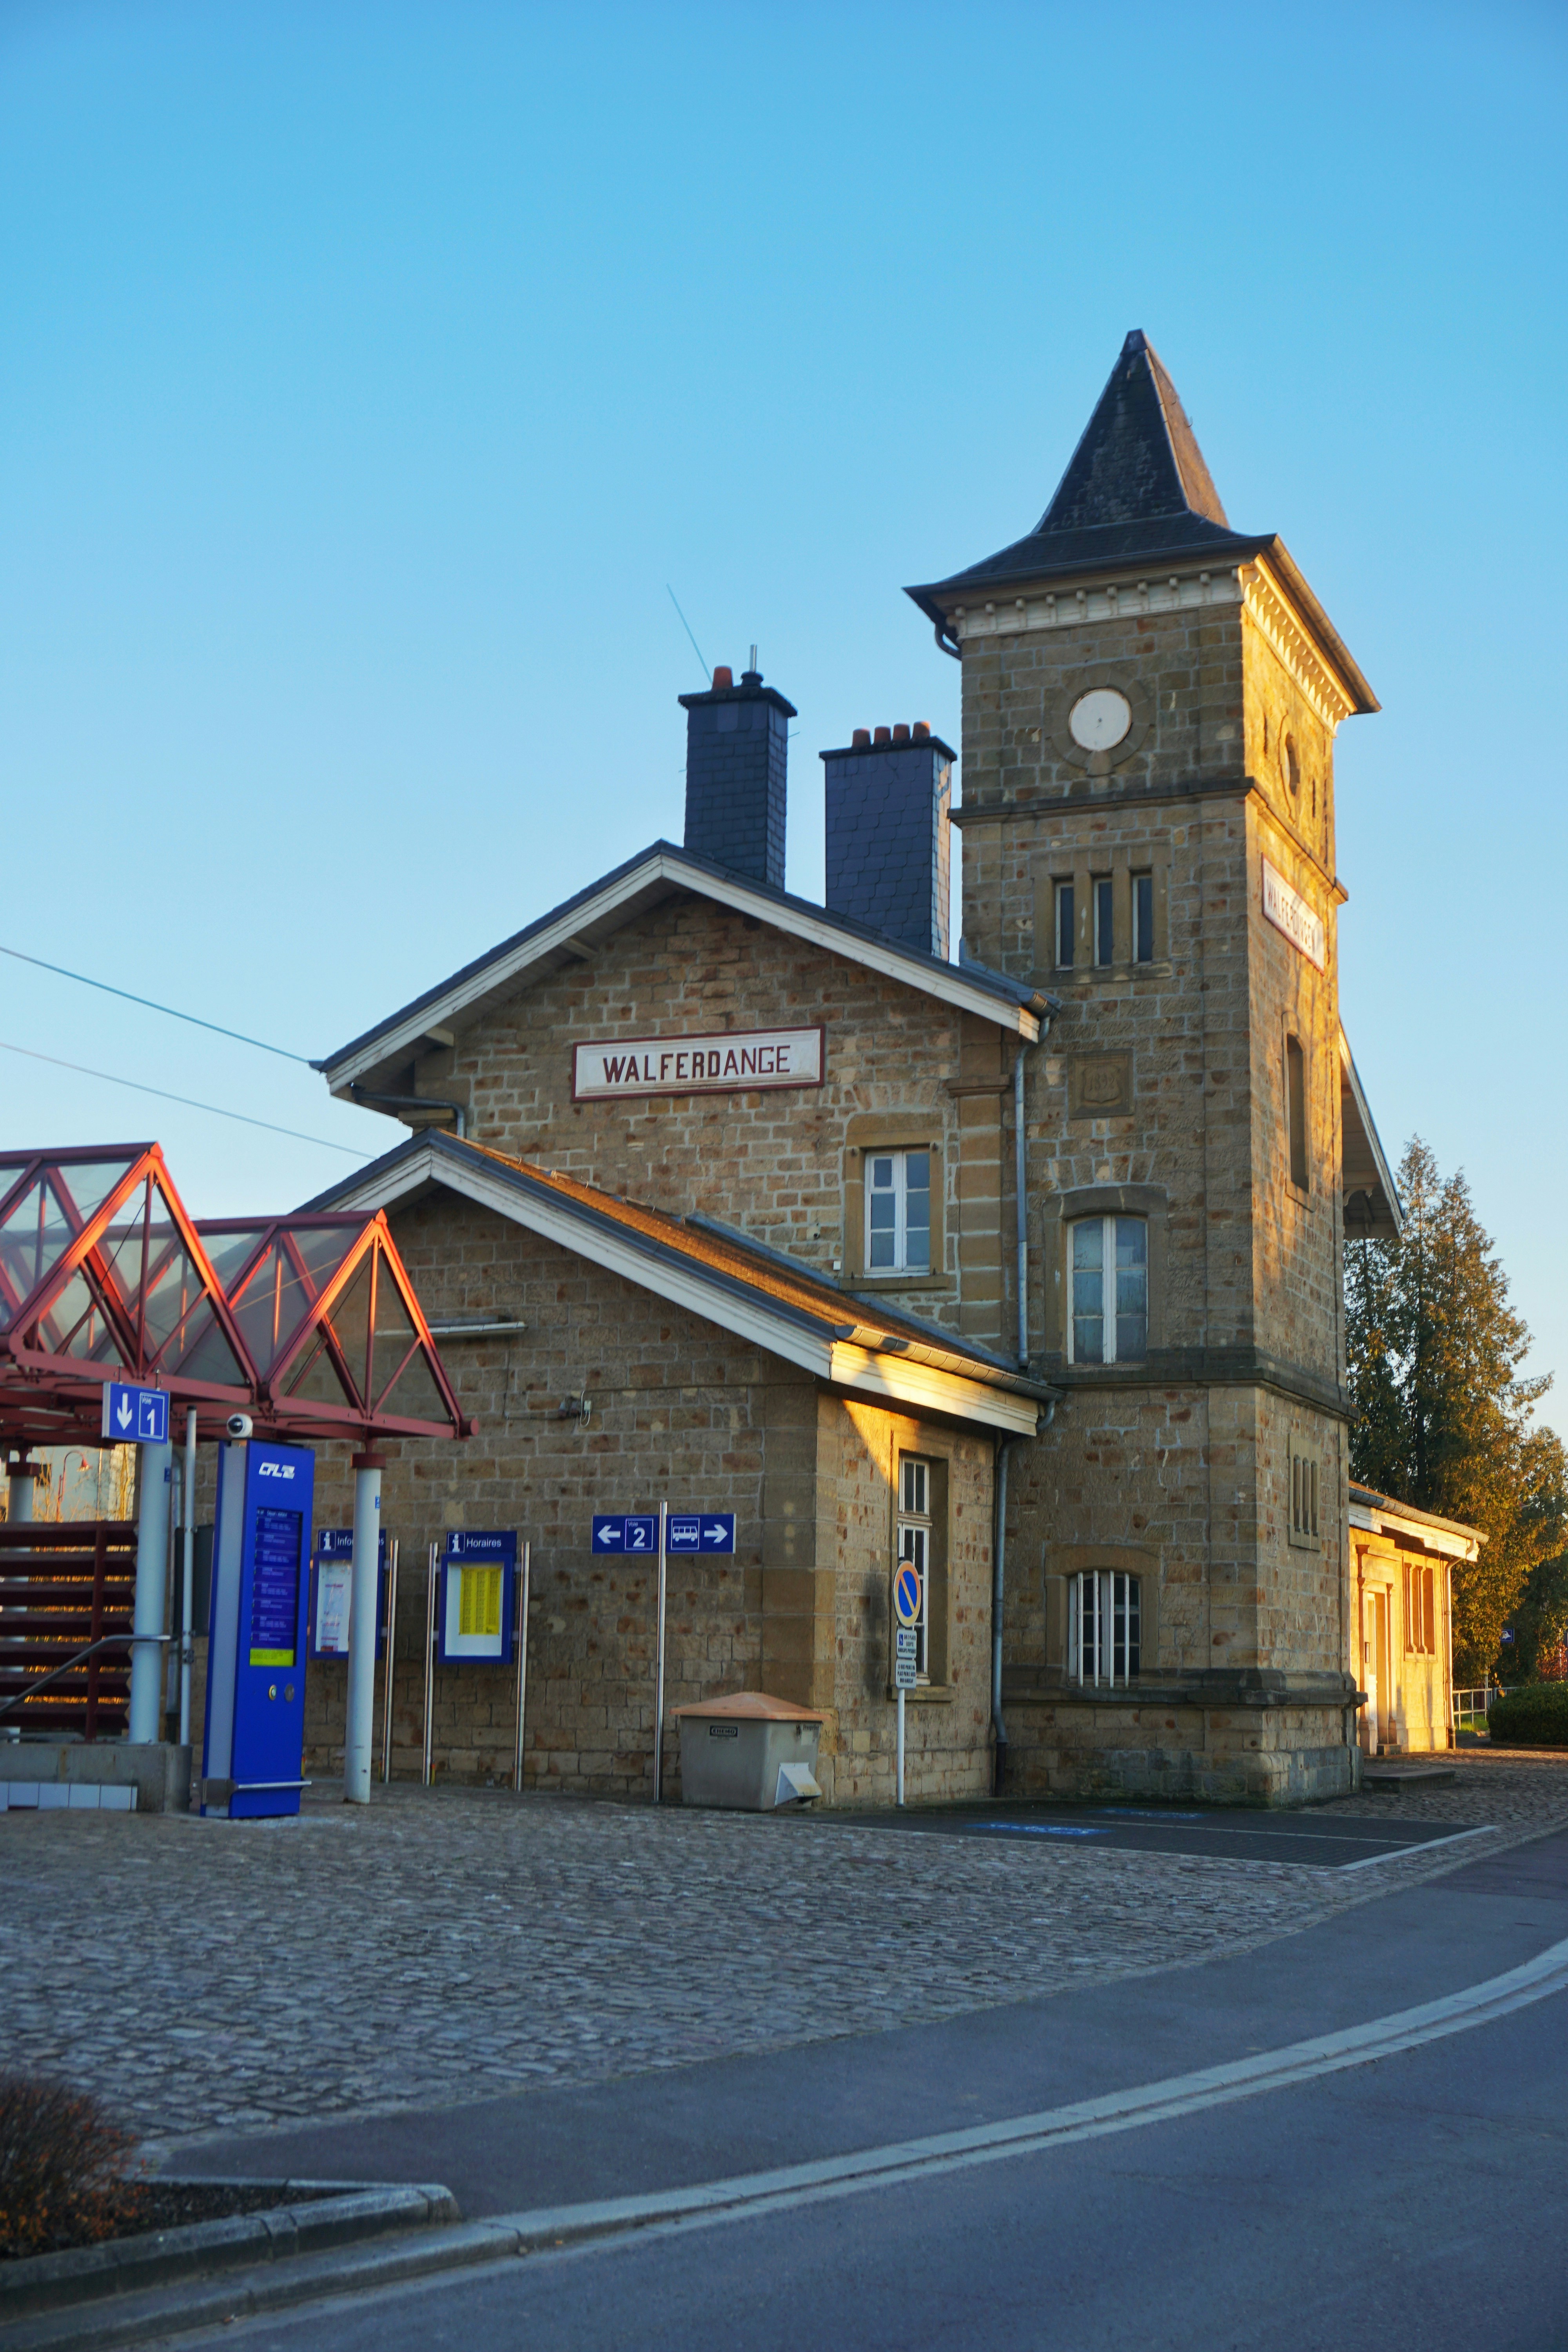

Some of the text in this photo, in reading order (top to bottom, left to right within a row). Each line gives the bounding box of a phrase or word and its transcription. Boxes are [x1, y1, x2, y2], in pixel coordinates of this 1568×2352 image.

[603, 1044, 791, 1083] WALFERDANGE
[147, 1408, 155, 1436] 1
[466, 1537, 501, 1548] Horaires
[633, 1527, 645, 1548] 2
